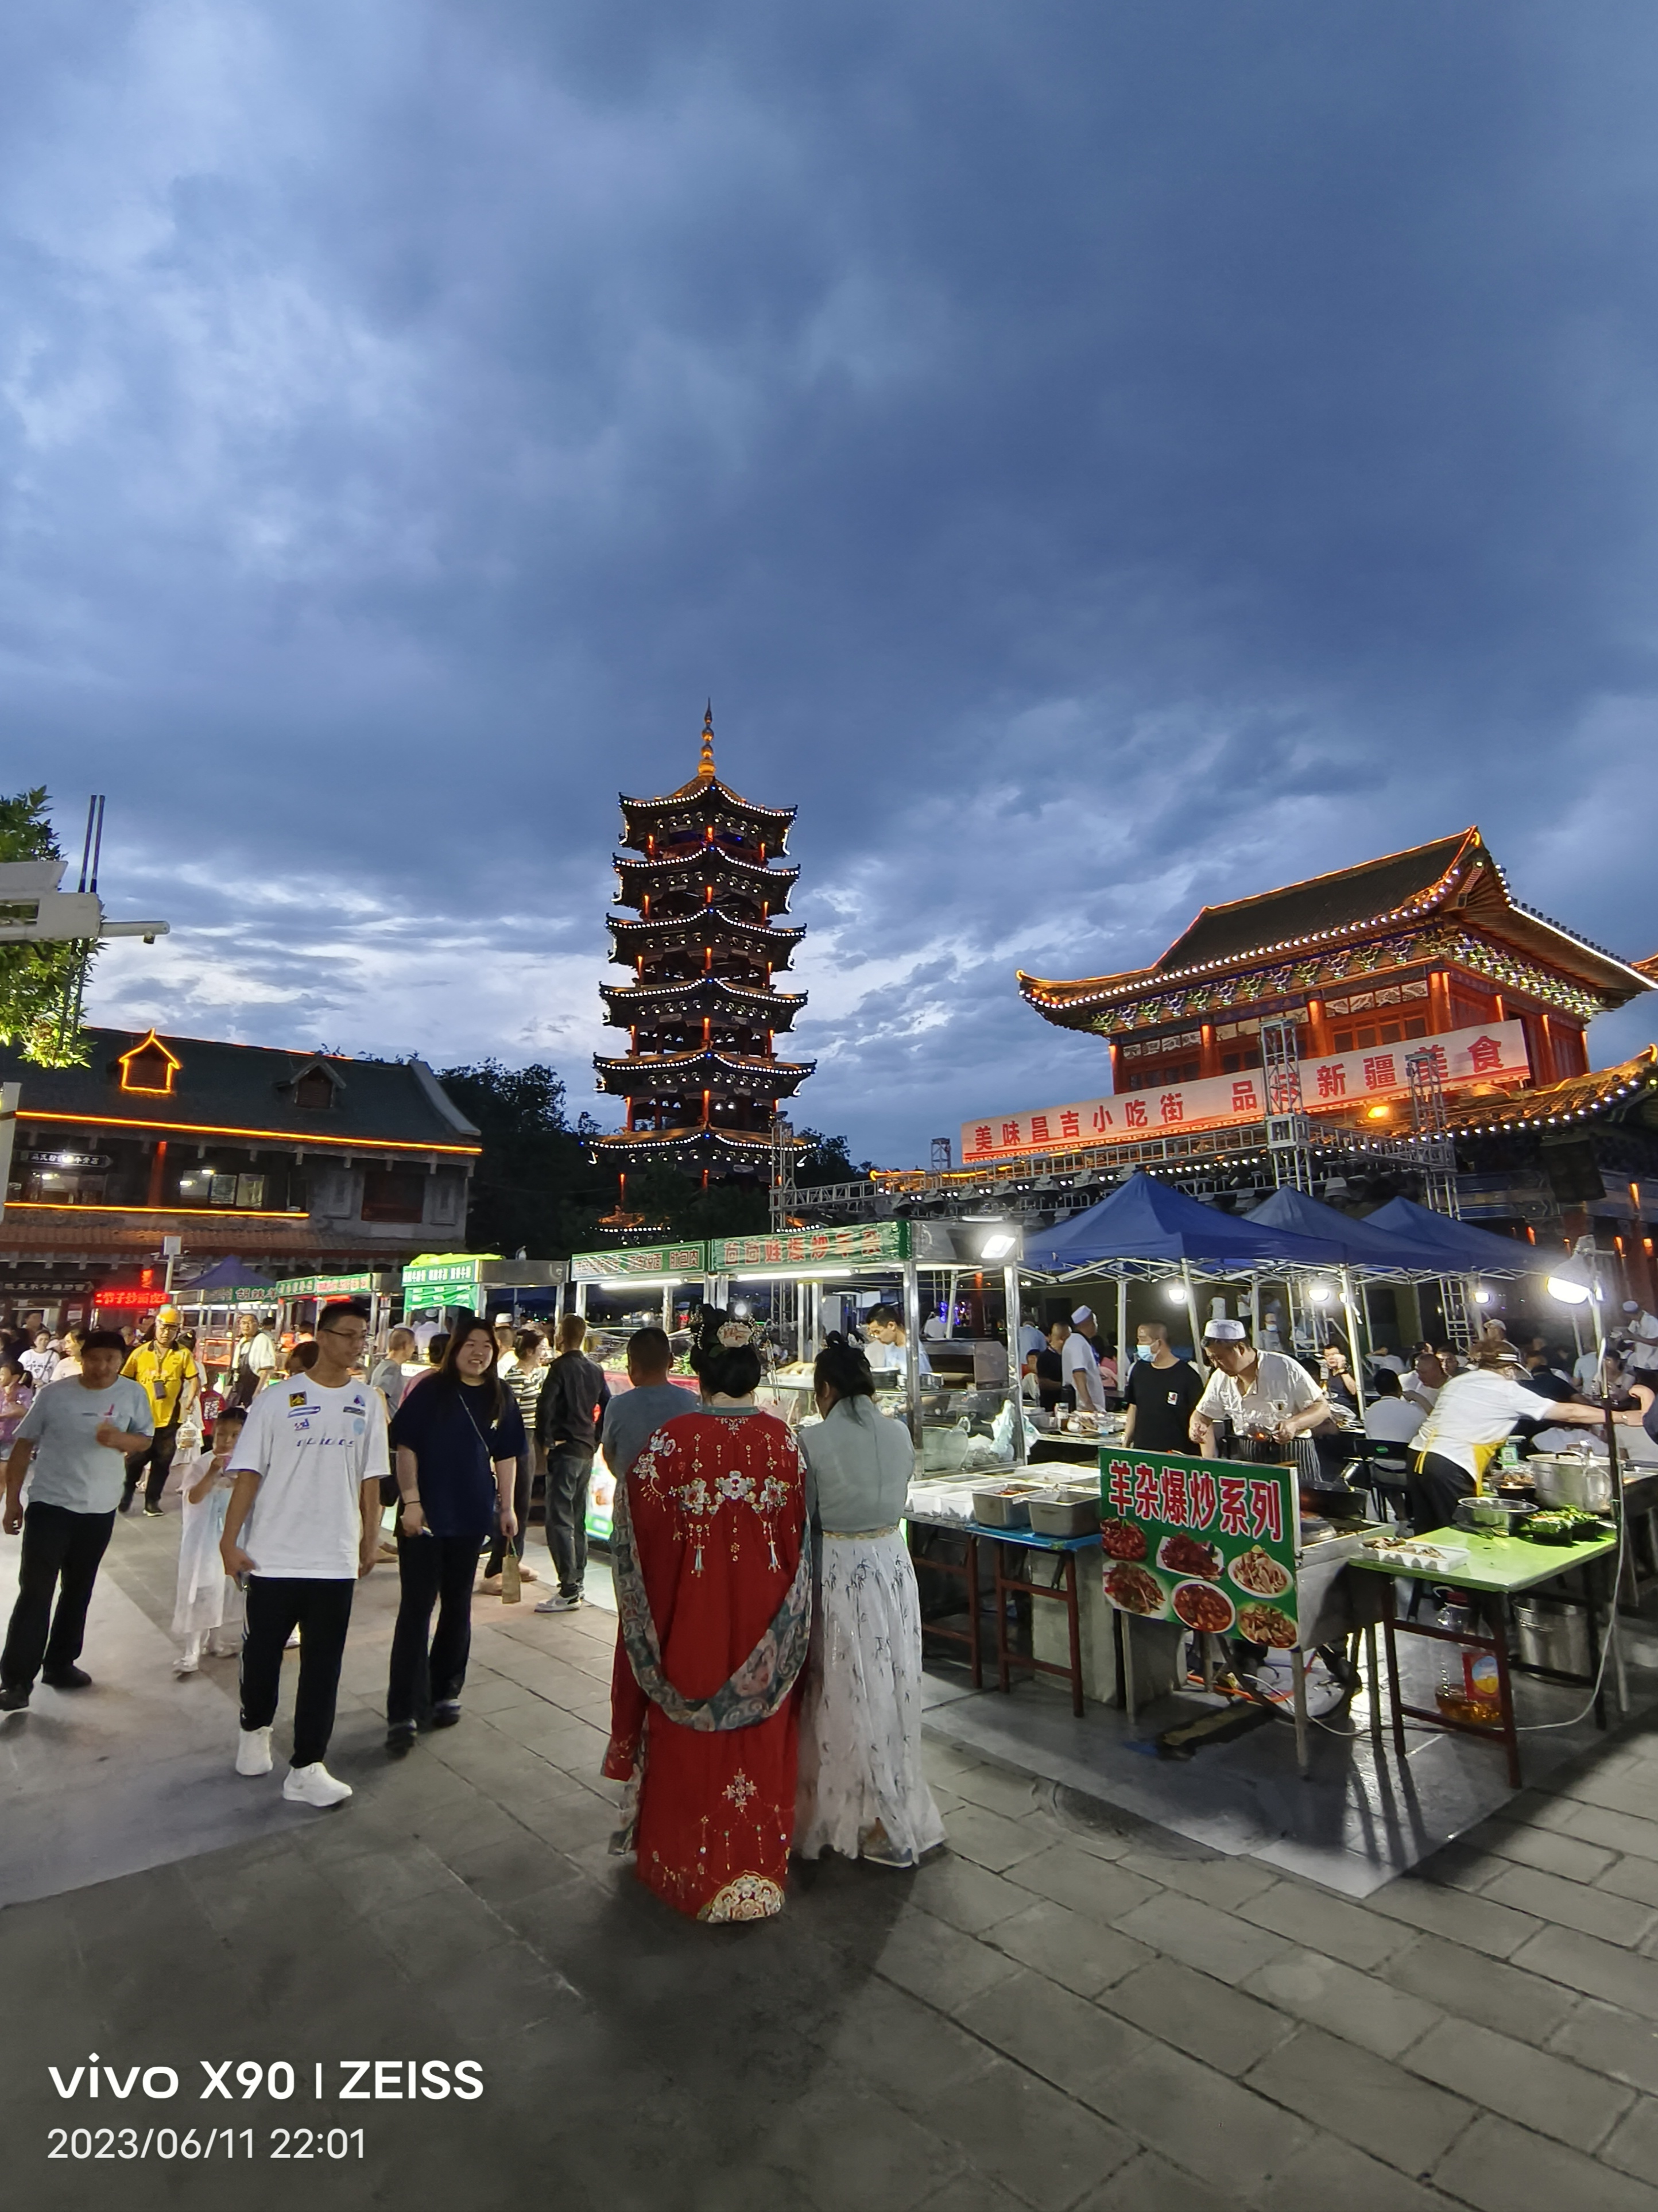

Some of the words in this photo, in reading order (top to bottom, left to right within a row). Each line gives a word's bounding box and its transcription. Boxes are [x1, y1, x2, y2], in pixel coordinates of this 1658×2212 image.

[975, 1093, 1184, 1151] 美味昌吉小吃街
[1109, 1459, 1284, 1542] 羊杂爆炒系列
